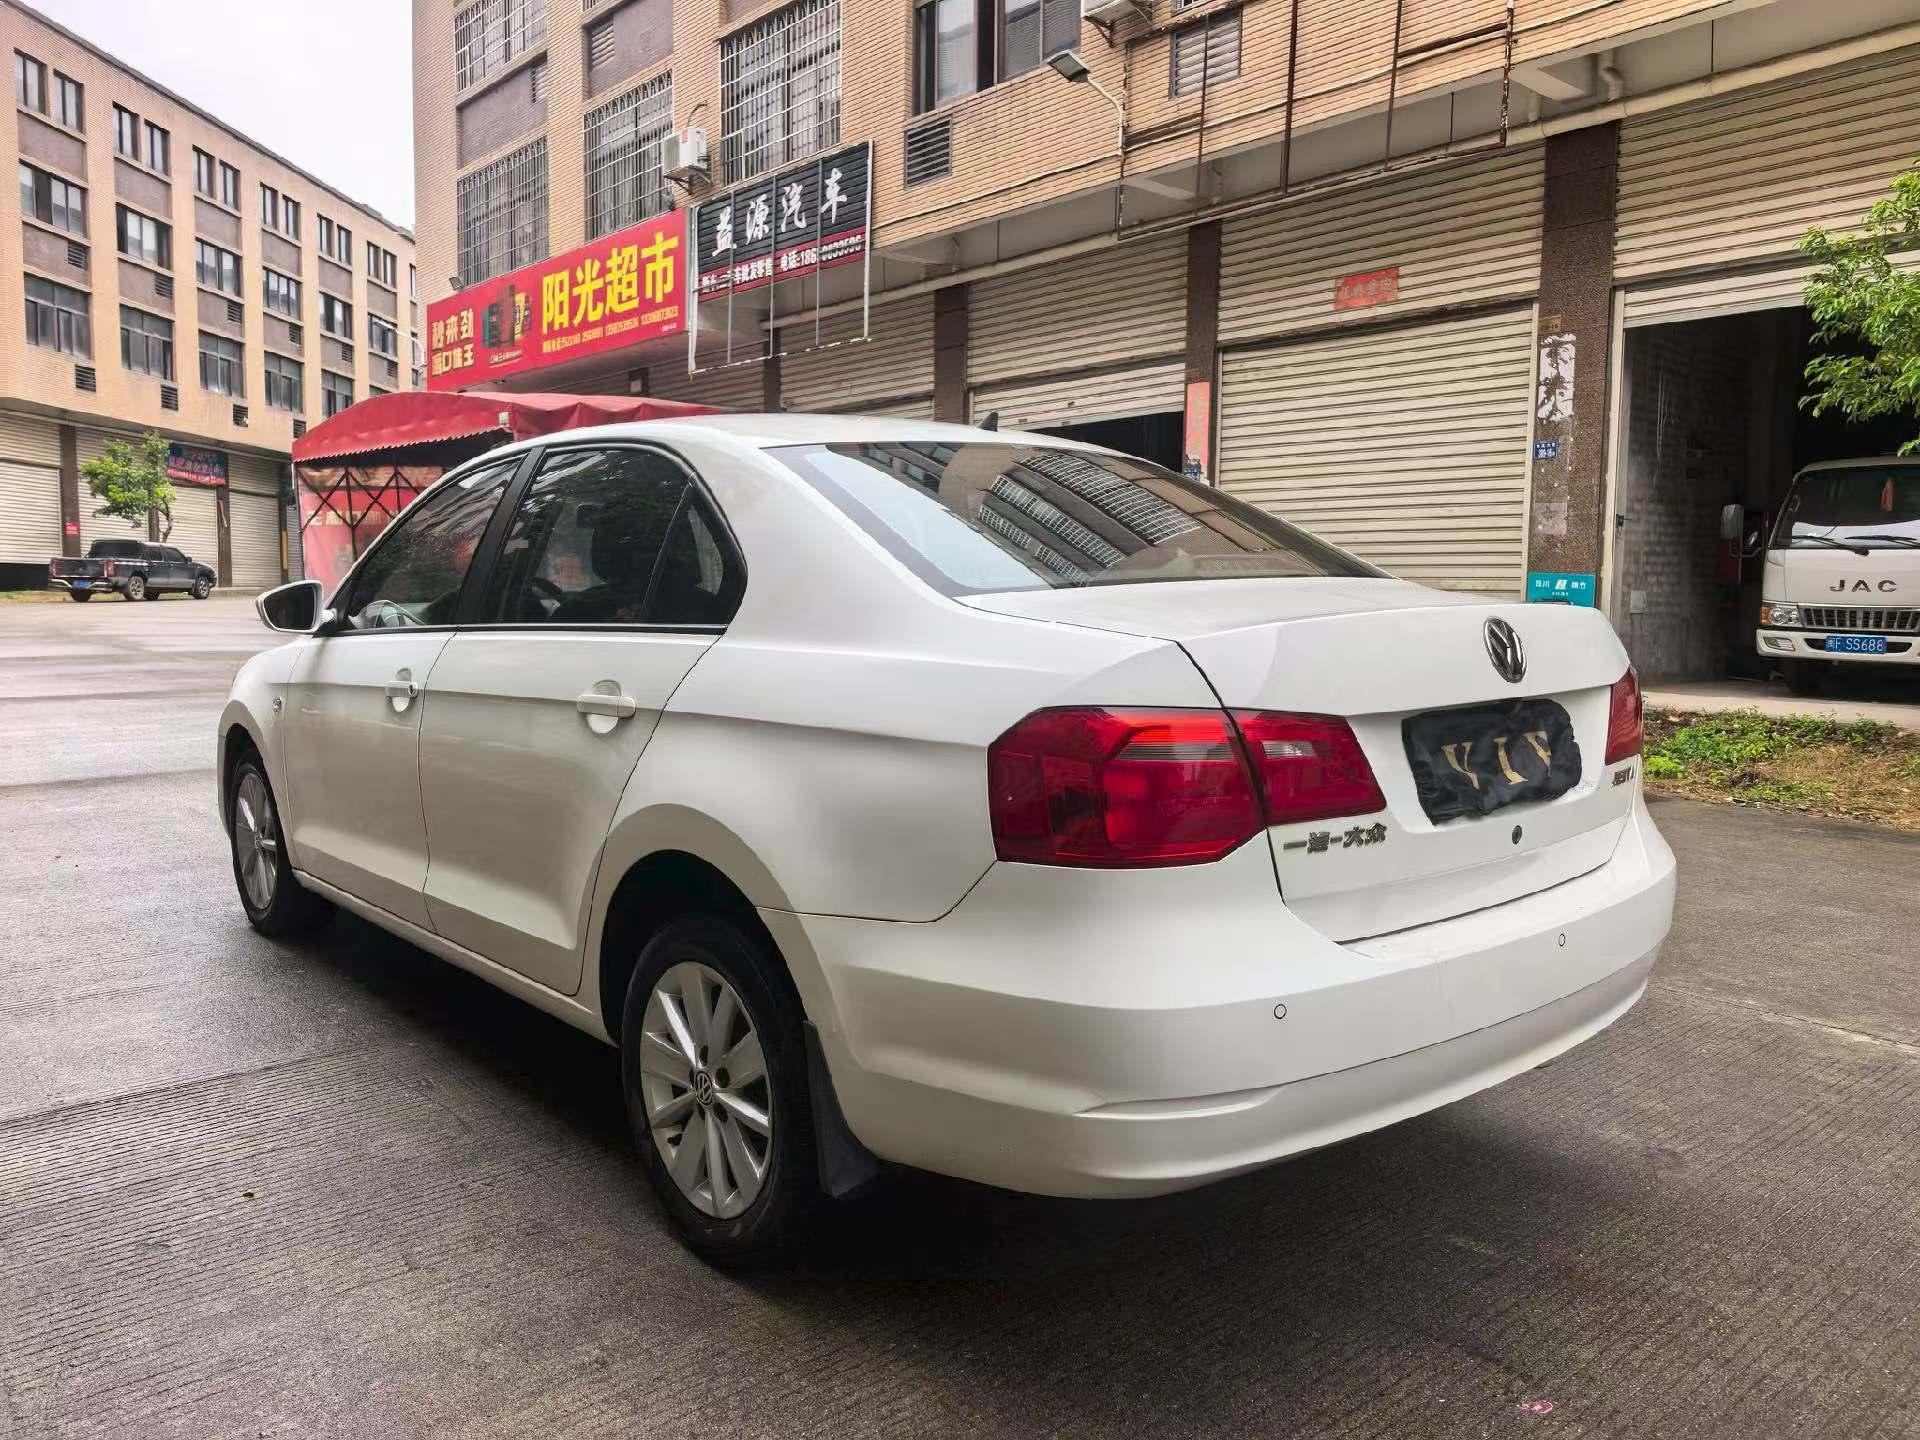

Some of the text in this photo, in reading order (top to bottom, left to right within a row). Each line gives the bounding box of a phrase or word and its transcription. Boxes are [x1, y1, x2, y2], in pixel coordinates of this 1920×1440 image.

[542, 232, 679, 335] 阳光超市
[1830, 580, 1897, 593] JAC
